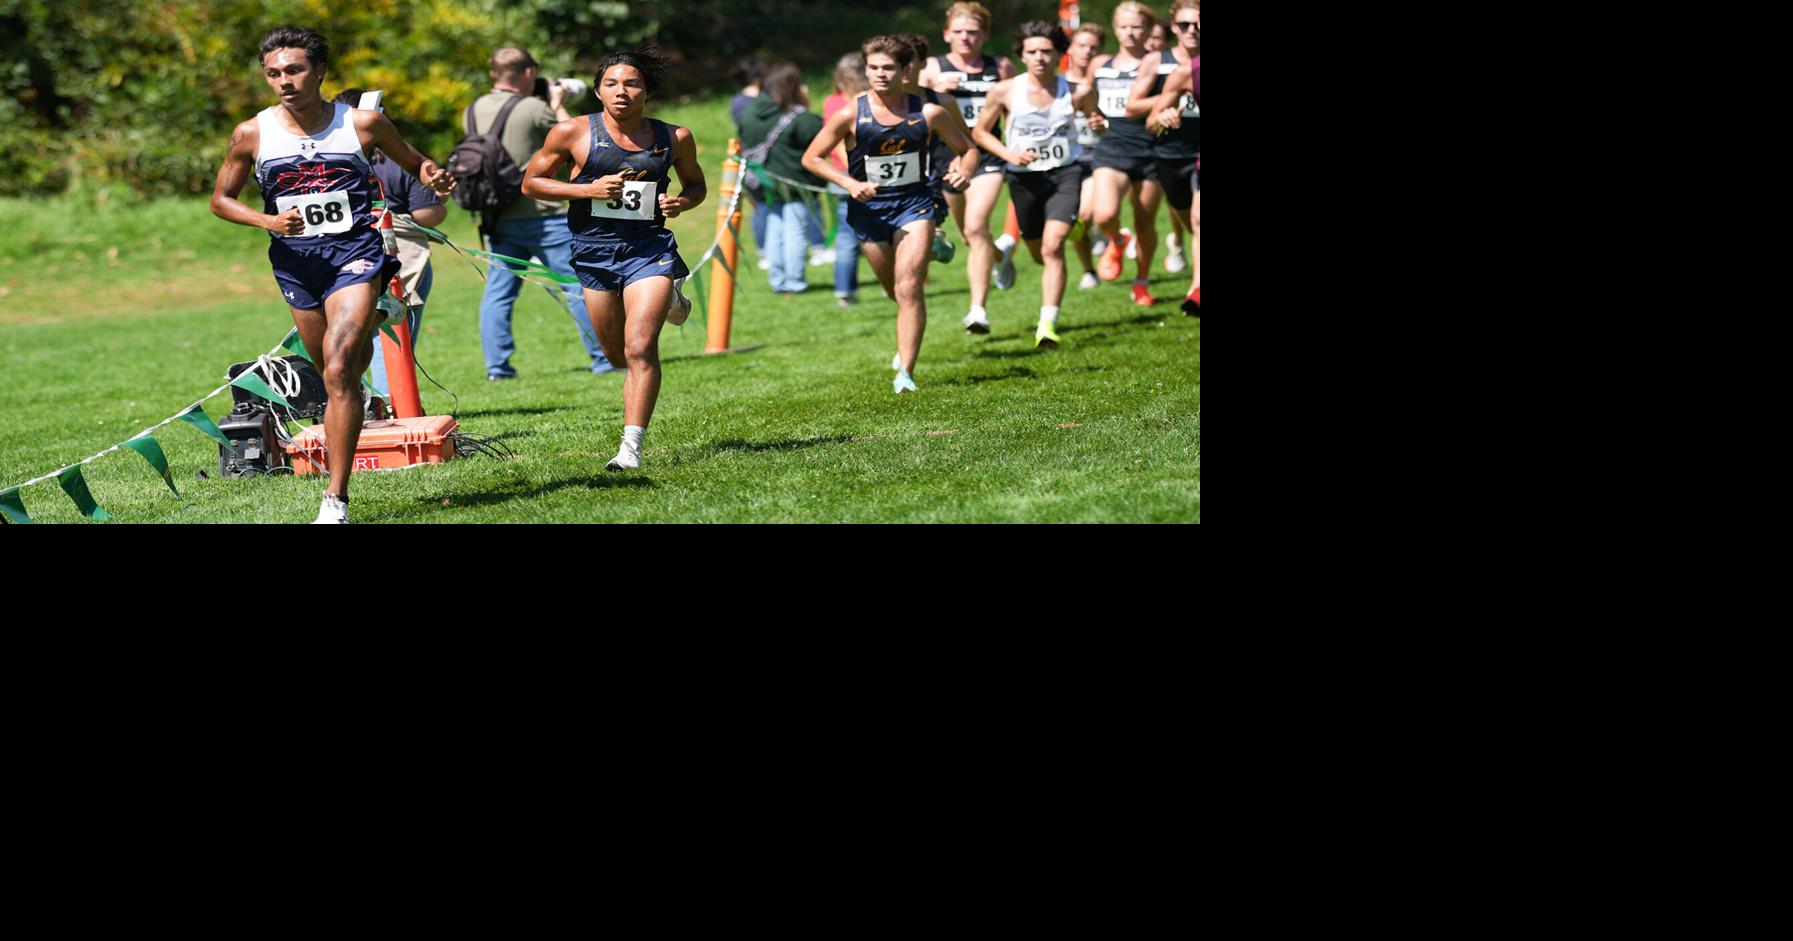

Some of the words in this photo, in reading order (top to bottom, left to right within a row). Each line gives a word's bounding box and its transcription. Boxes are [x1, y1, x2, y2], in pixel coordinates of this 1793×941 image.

[880, 137, 906, 153] Cal
[880, 162, 907, 179] 37
[606, 190, 642, 211] 33
